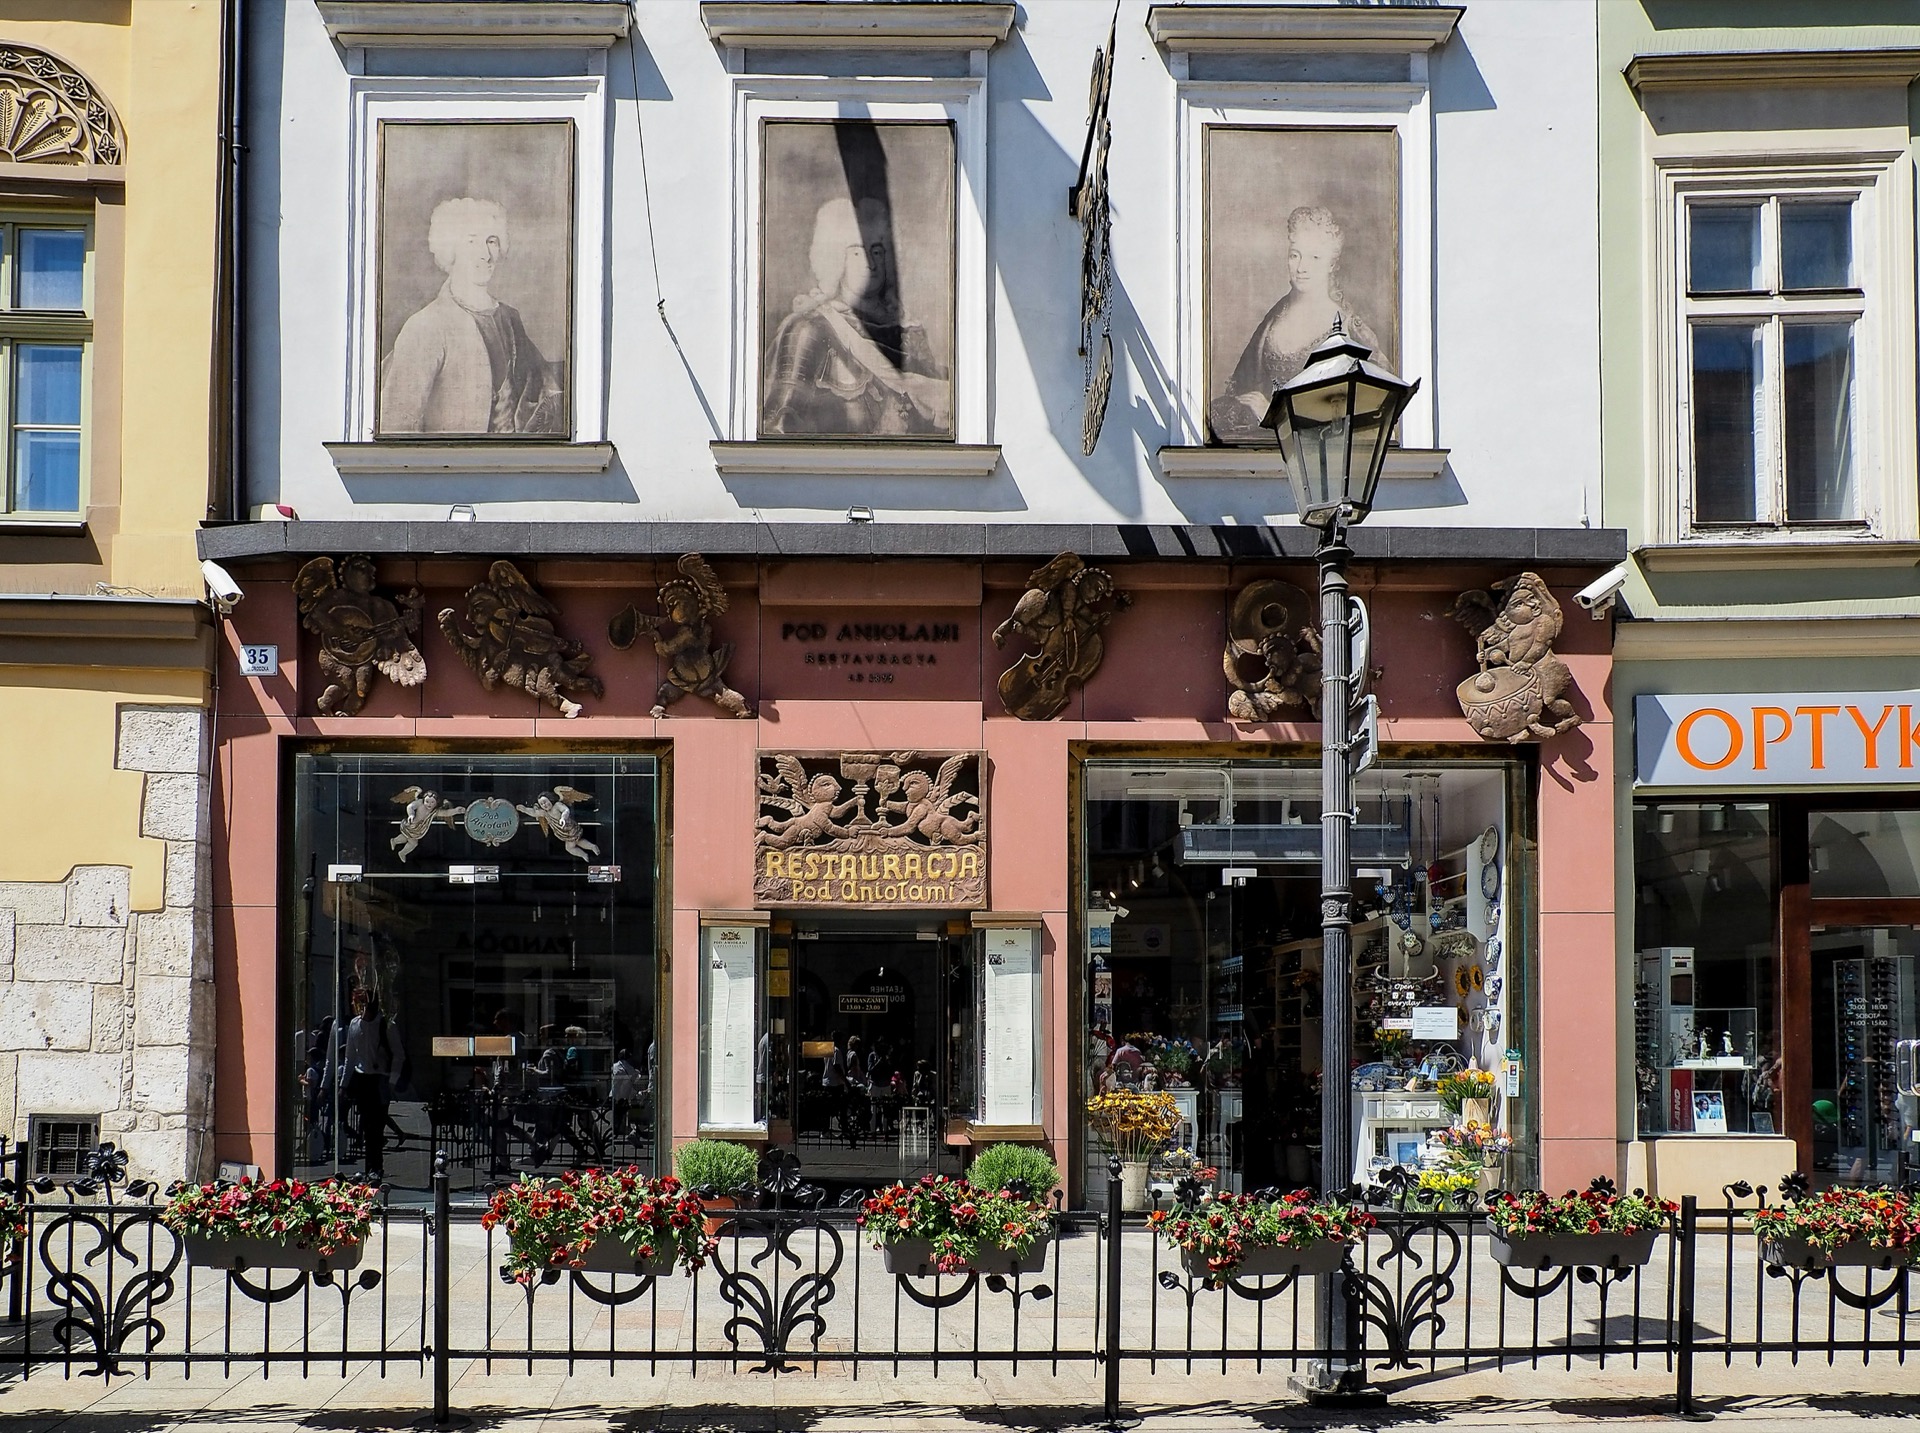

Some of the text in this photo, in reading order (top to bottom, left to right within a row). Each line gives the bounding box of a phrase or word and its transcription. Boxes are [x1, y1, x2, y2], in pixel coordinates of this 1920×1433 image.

[782, 623, 827, 641] POD
[247, 648, 269, 665] 35
[481, 812, 499, 820] Pod
[765, 852, 978, 881] RESTAURACJA
[792, 881, 832, 901] Pod
[1387, 999, 1421, 1008] everyday
